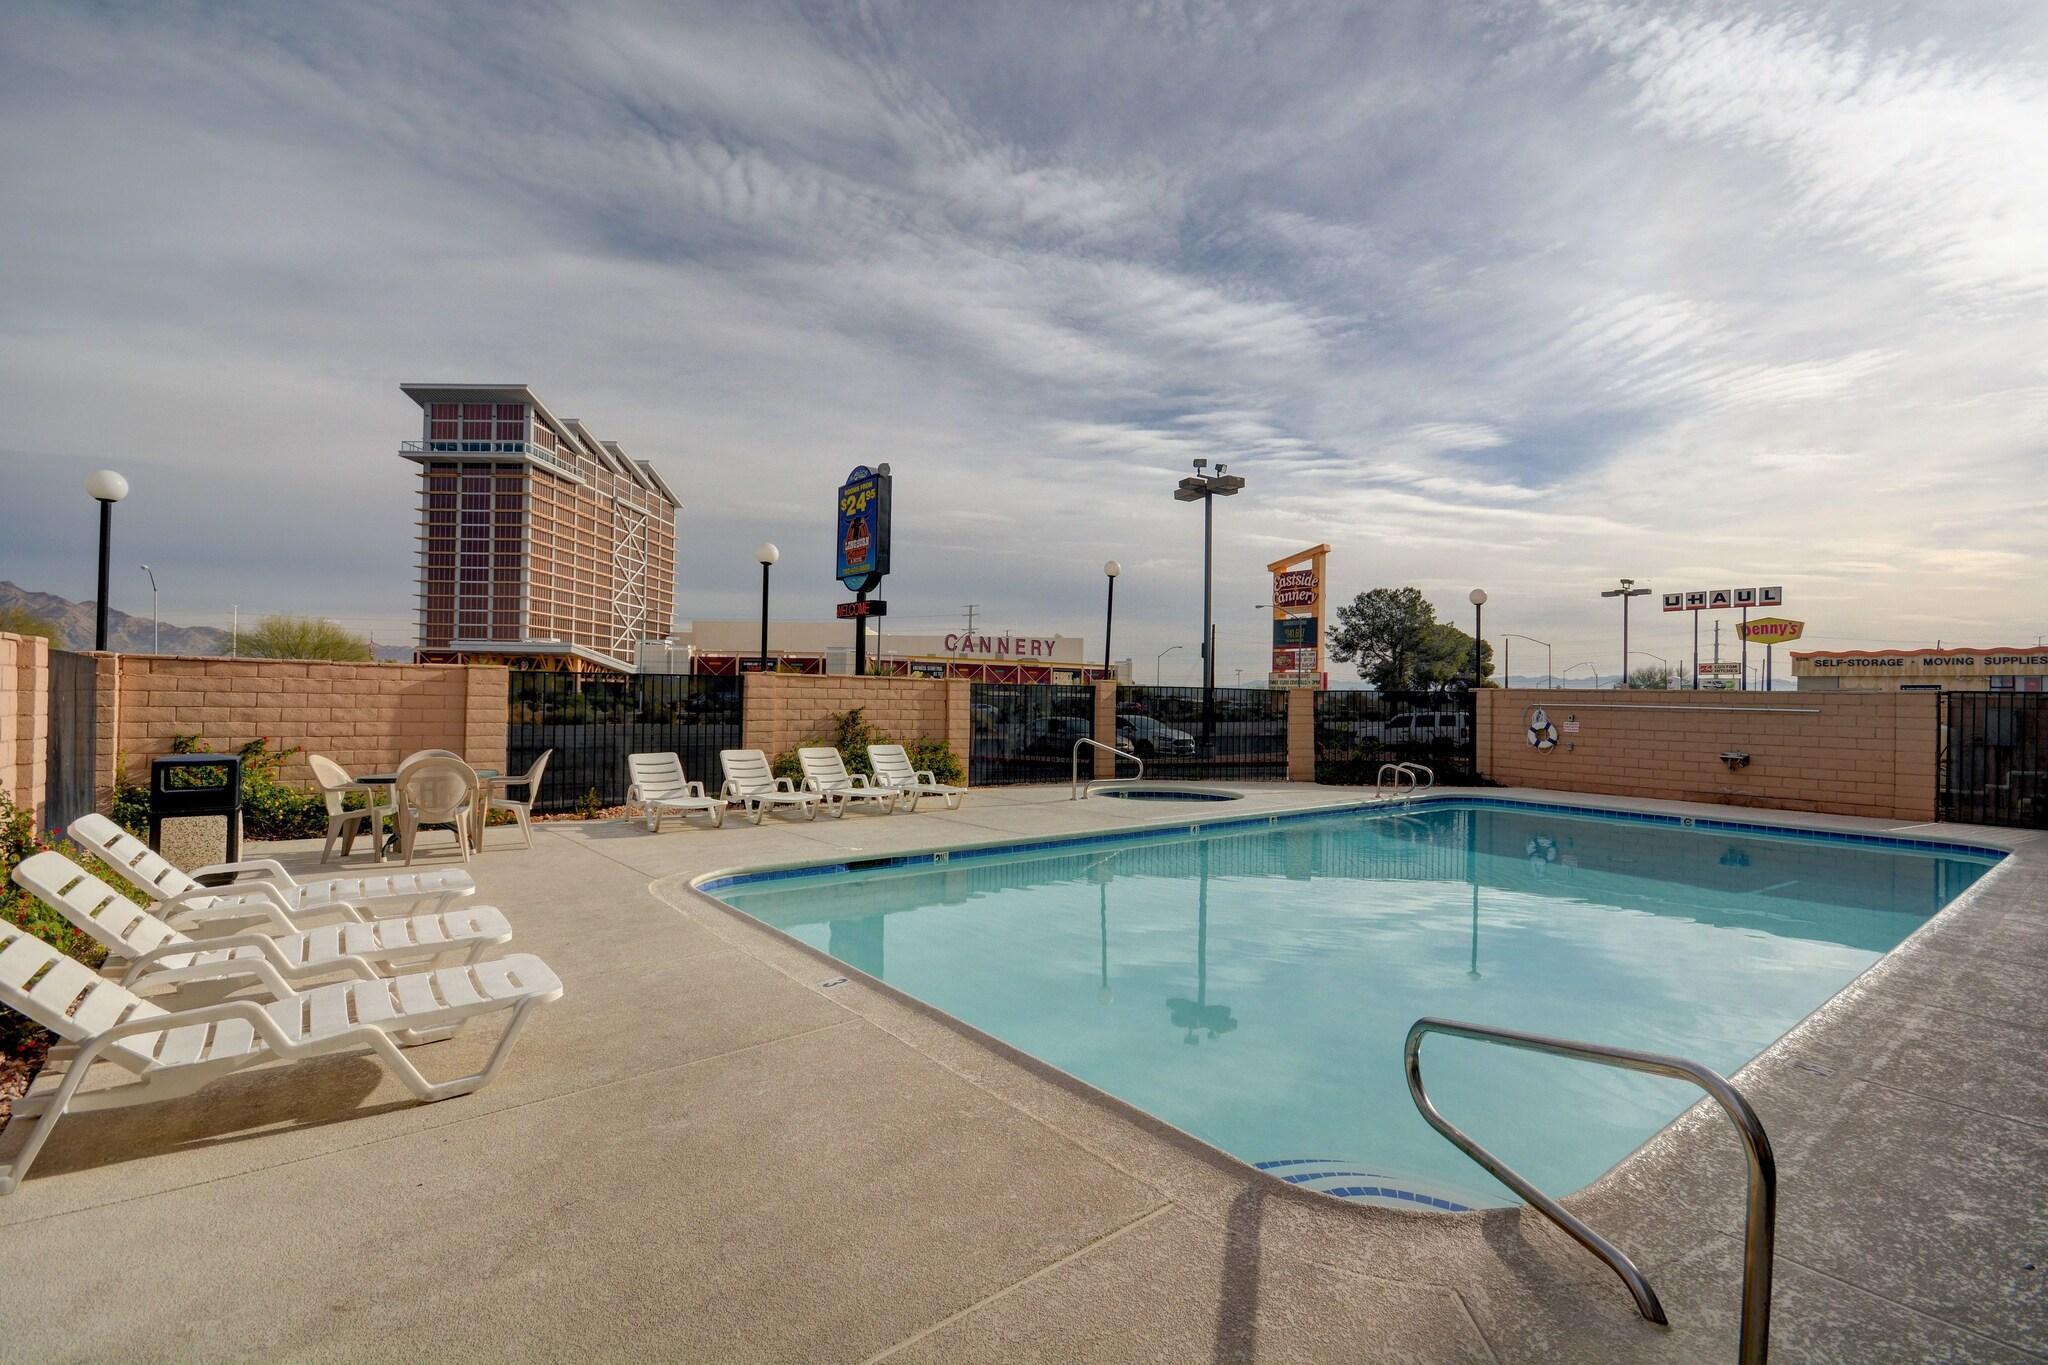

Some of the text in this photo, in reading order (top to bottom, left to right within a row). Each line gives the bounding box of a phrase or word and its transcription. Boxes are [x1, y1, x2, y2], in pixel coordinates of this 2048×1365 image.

[1274, 573, 1319, 591] Eastside
[1273, 591, 1318, 606] Cannery
[837, 602, 870, 617] WELCOME
[944, 633, 1056, 657] CANNERY
[1814, 656, 2048, 667] SELF-STORAGE MOVING SUPPLIES
